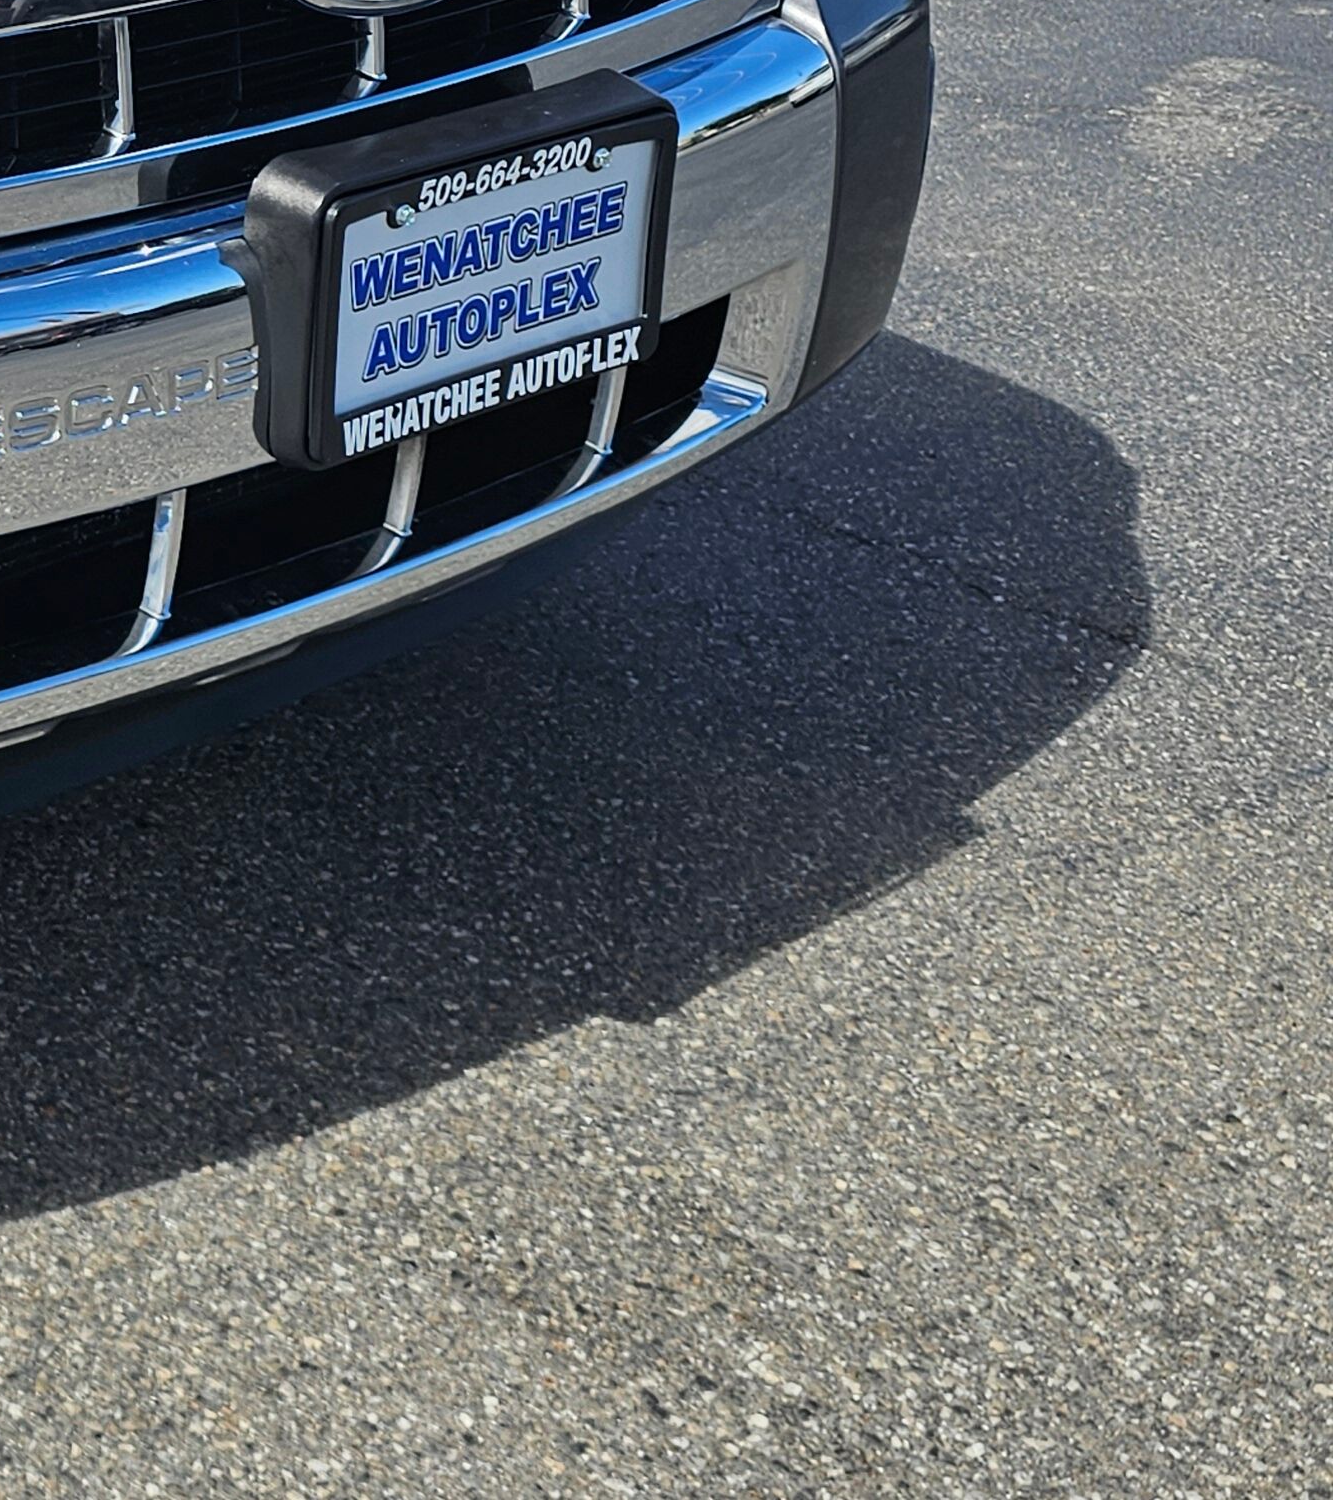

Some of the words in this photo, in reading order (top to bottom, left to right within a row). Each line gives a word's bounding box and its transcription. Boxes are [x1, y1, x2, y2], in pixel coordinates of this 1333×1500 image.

[418, 136, 592, 210] 509-664-3200
[351, 182, 627, 310] WENATCHEE
[363, 259, 600, 381] AUTOPLEX
[343, 374, 501, 456] WENATCHEE
